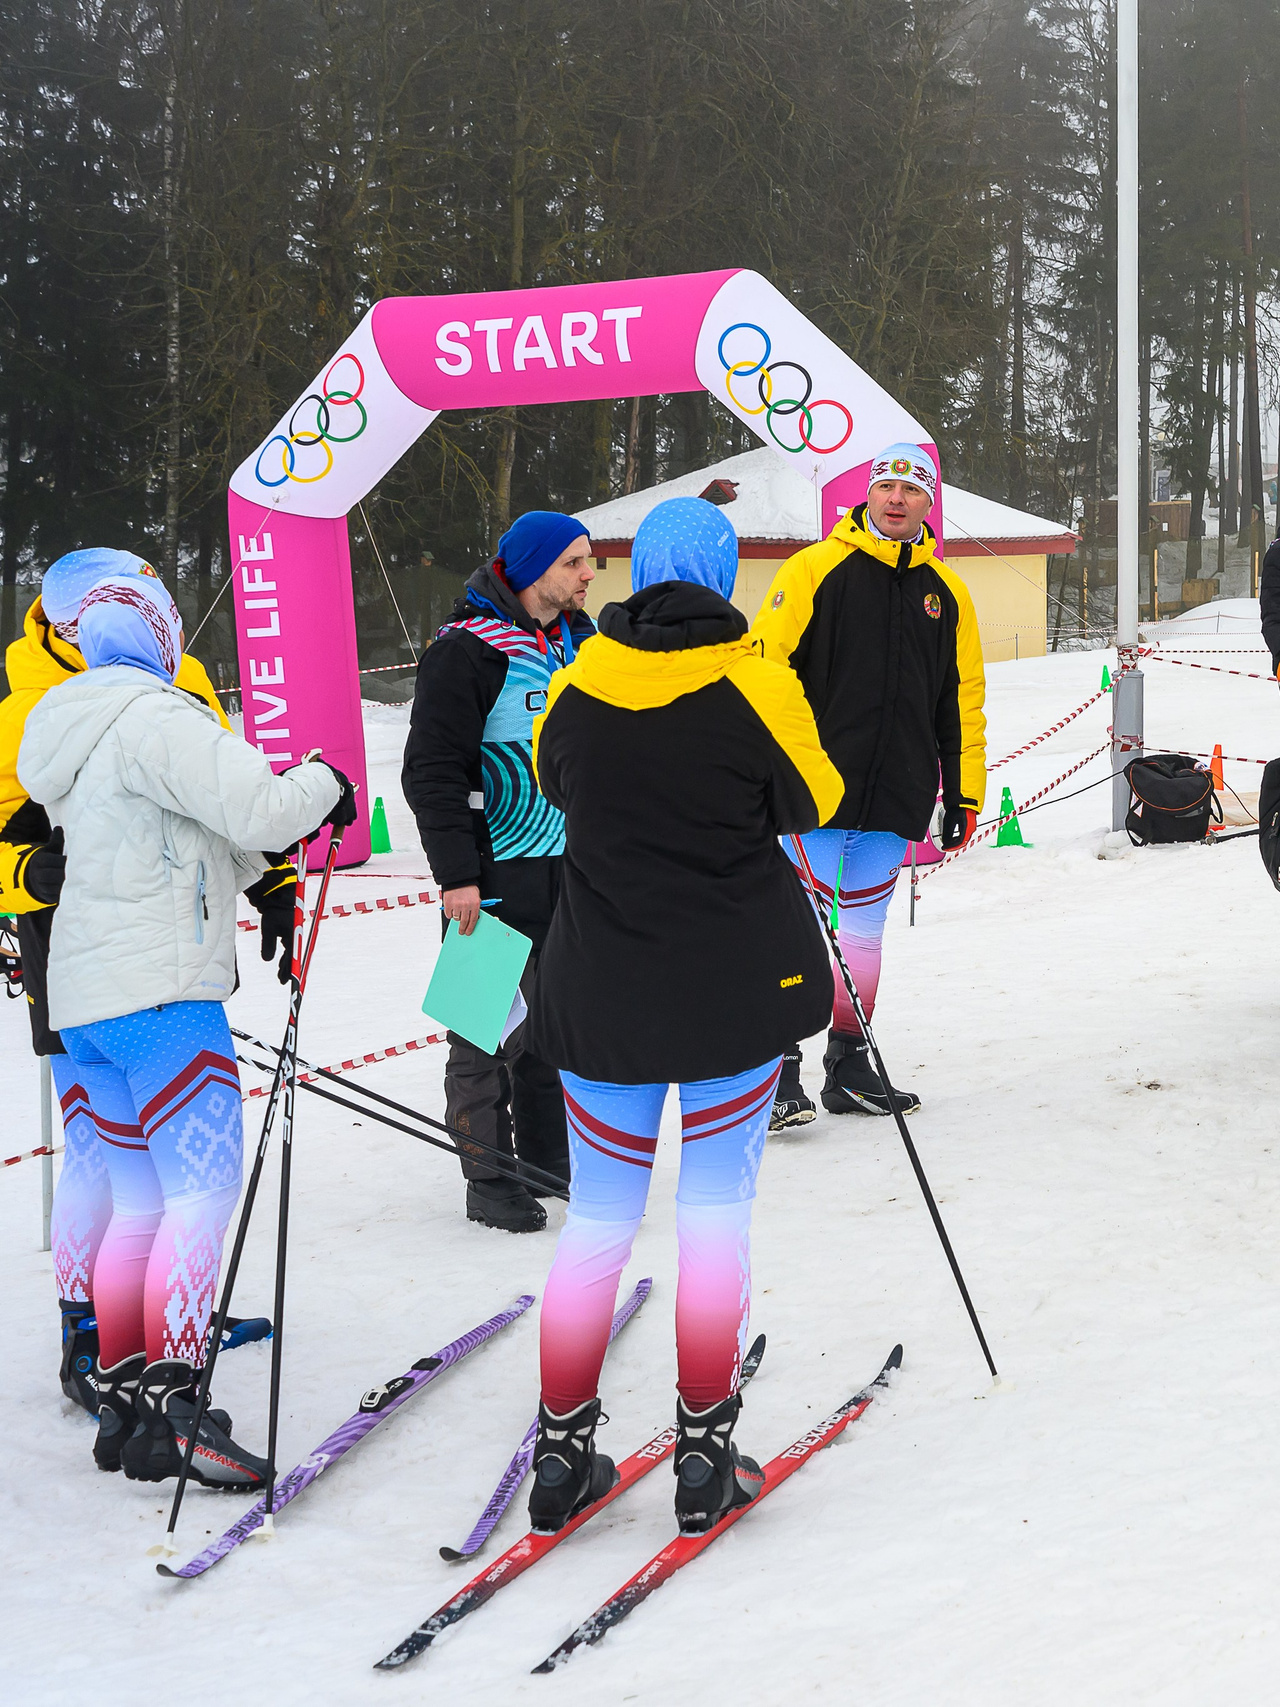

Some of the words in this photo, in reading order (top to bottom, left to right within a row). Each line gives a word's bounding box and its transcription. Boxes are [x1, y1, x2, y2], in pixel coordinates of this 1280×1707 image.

[433, 305, 644, 377] START
[238, 532, 282, 638] LIFE
[780, 974, 804, 989] ORAZ
[486, 1558, 513, 1583] SPORT
[637, 1560, 663, 1584] SPORT
